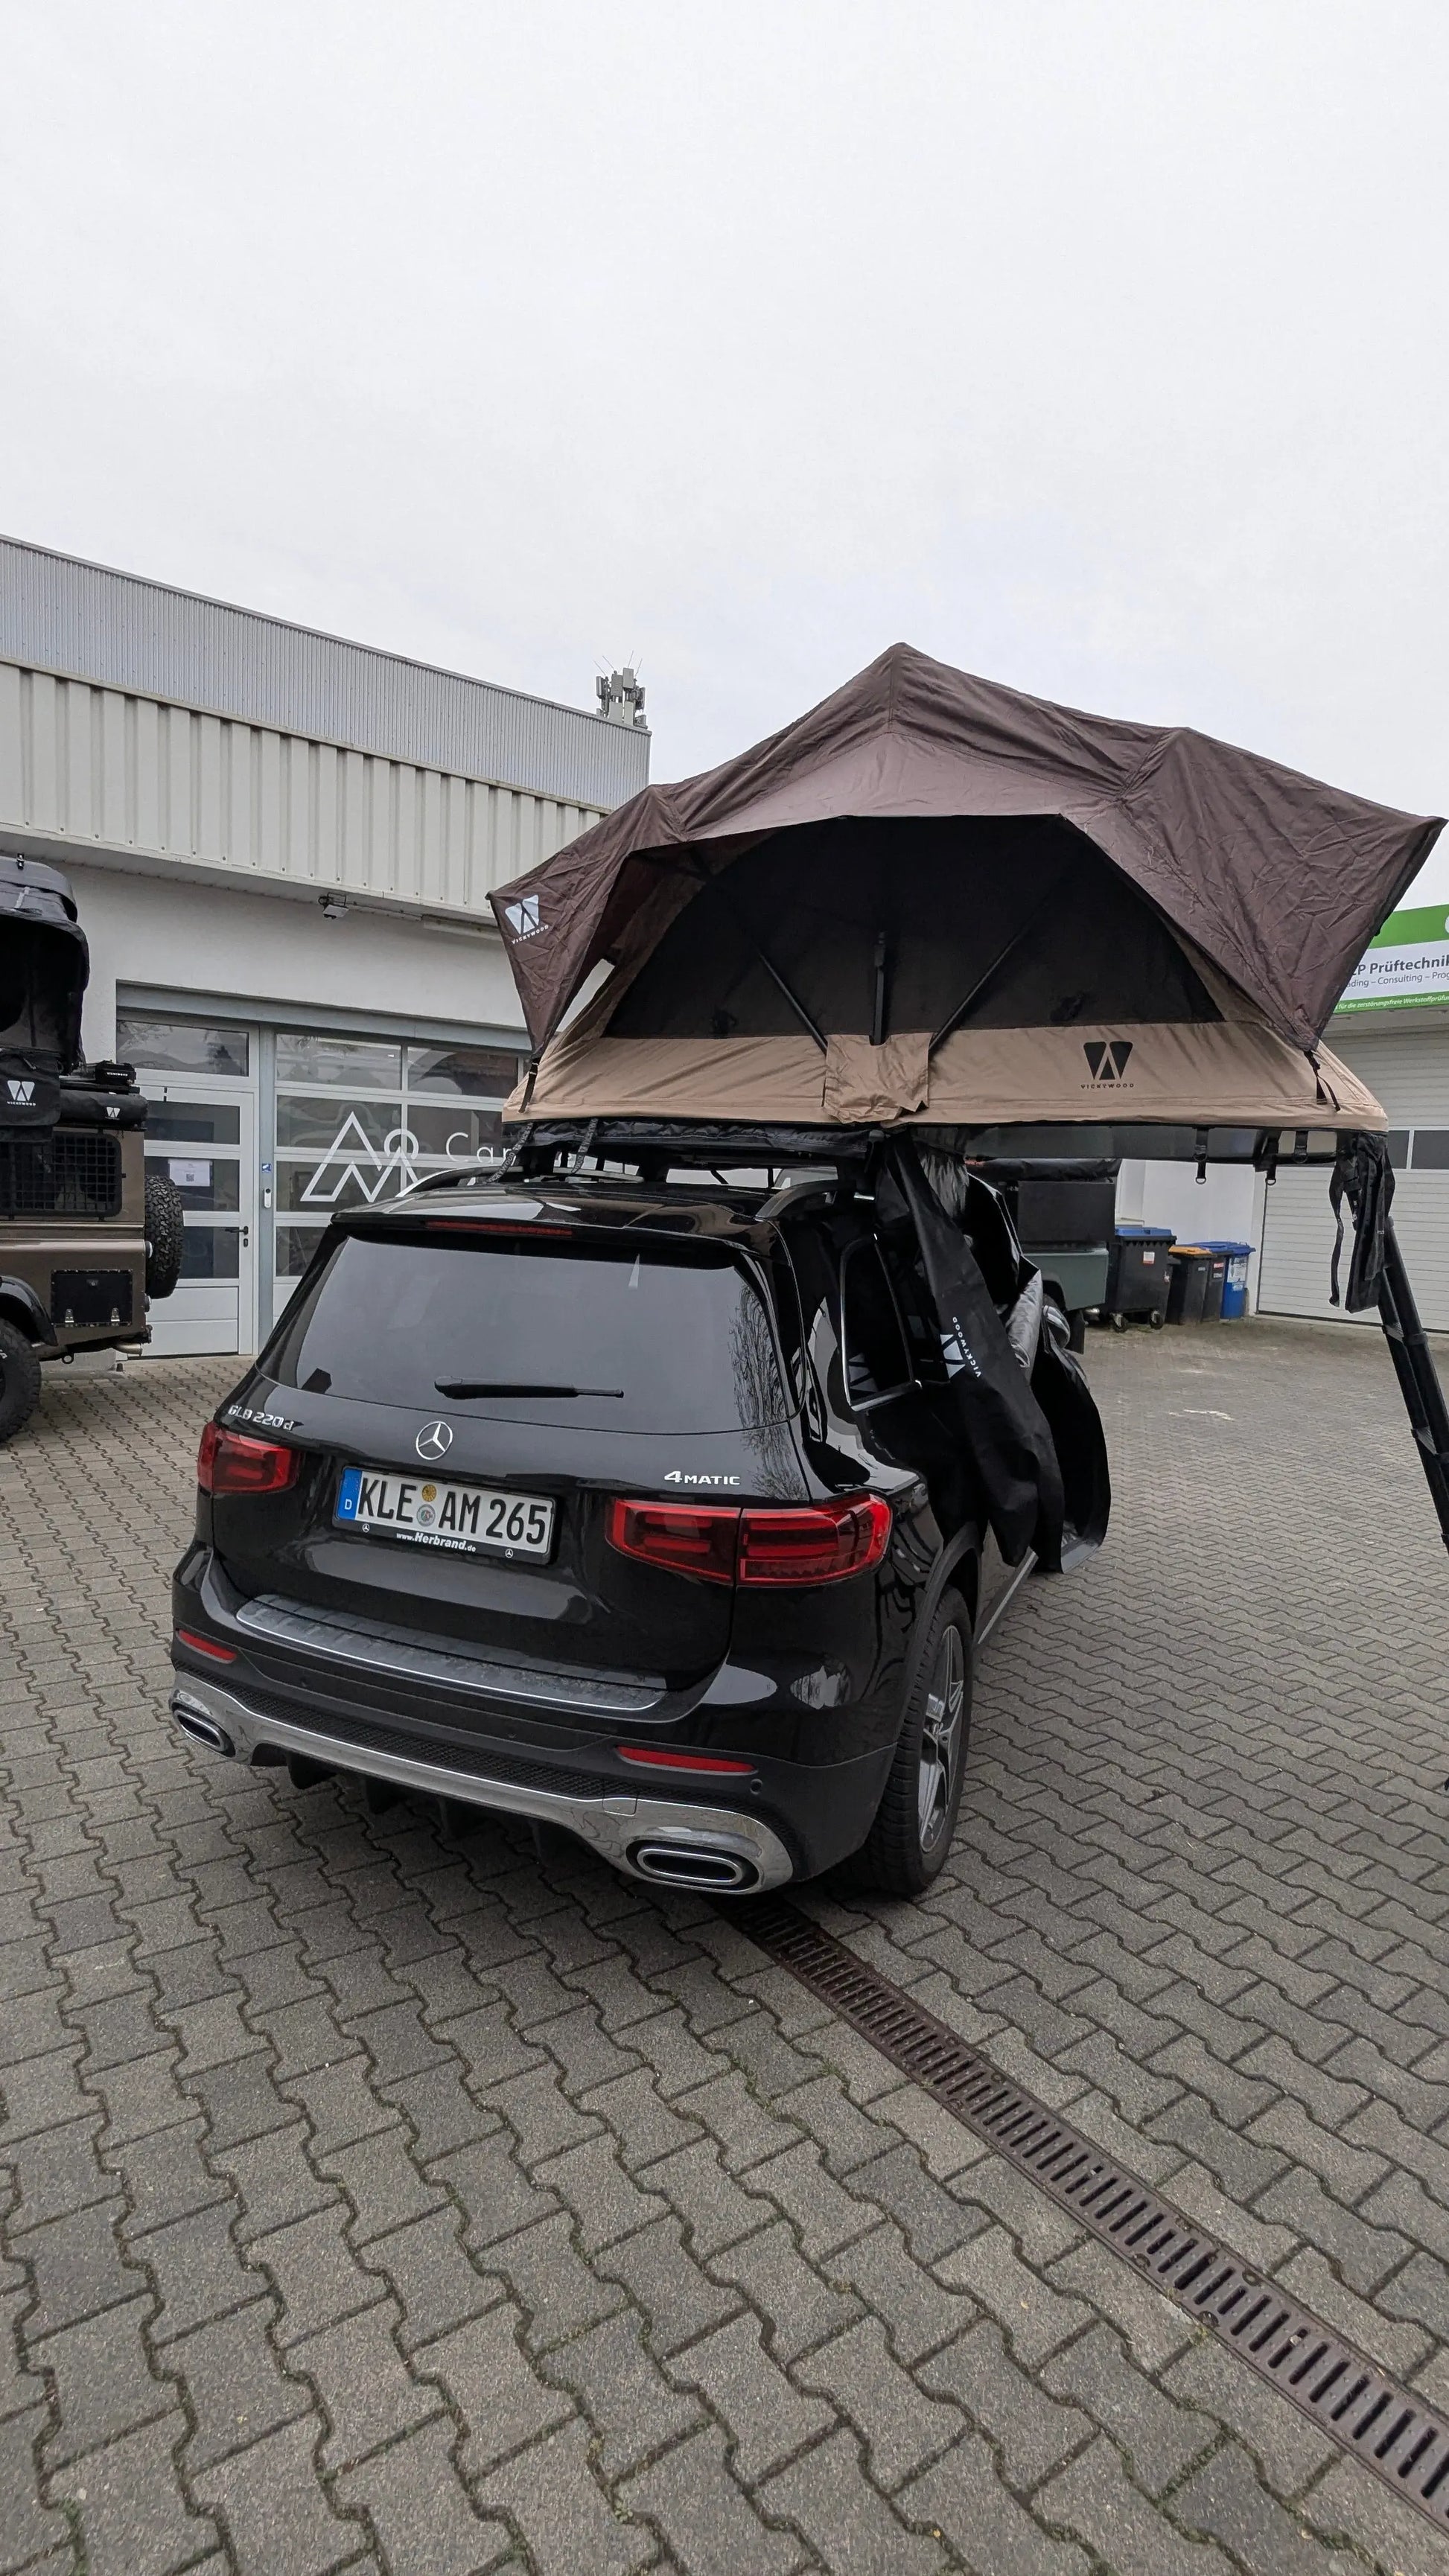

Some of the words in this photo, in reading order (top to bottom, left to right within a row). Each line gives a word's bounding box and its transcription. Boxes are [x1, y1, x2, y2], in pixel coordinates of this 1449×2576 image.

[512, 925, 549, 945] VICKYWOOD
[1352, 963, 1366, 975] P
[1378, 974, 1423, 985] Consulting
[952, 1316, 982, 1377] VICKYWOOD
[228, 1405, 253, 1421] GLB
[664, 1470, 740, 1485] 4MATIC
[344, 1498, 352, 1511] D
[357, 1477, 417, 1523] KLE
[438, 1491, 482, 1534] AM
[485, 1498, 548, 1545] 265
[395, 1531, 477, 1553] www.Herbrand.de
